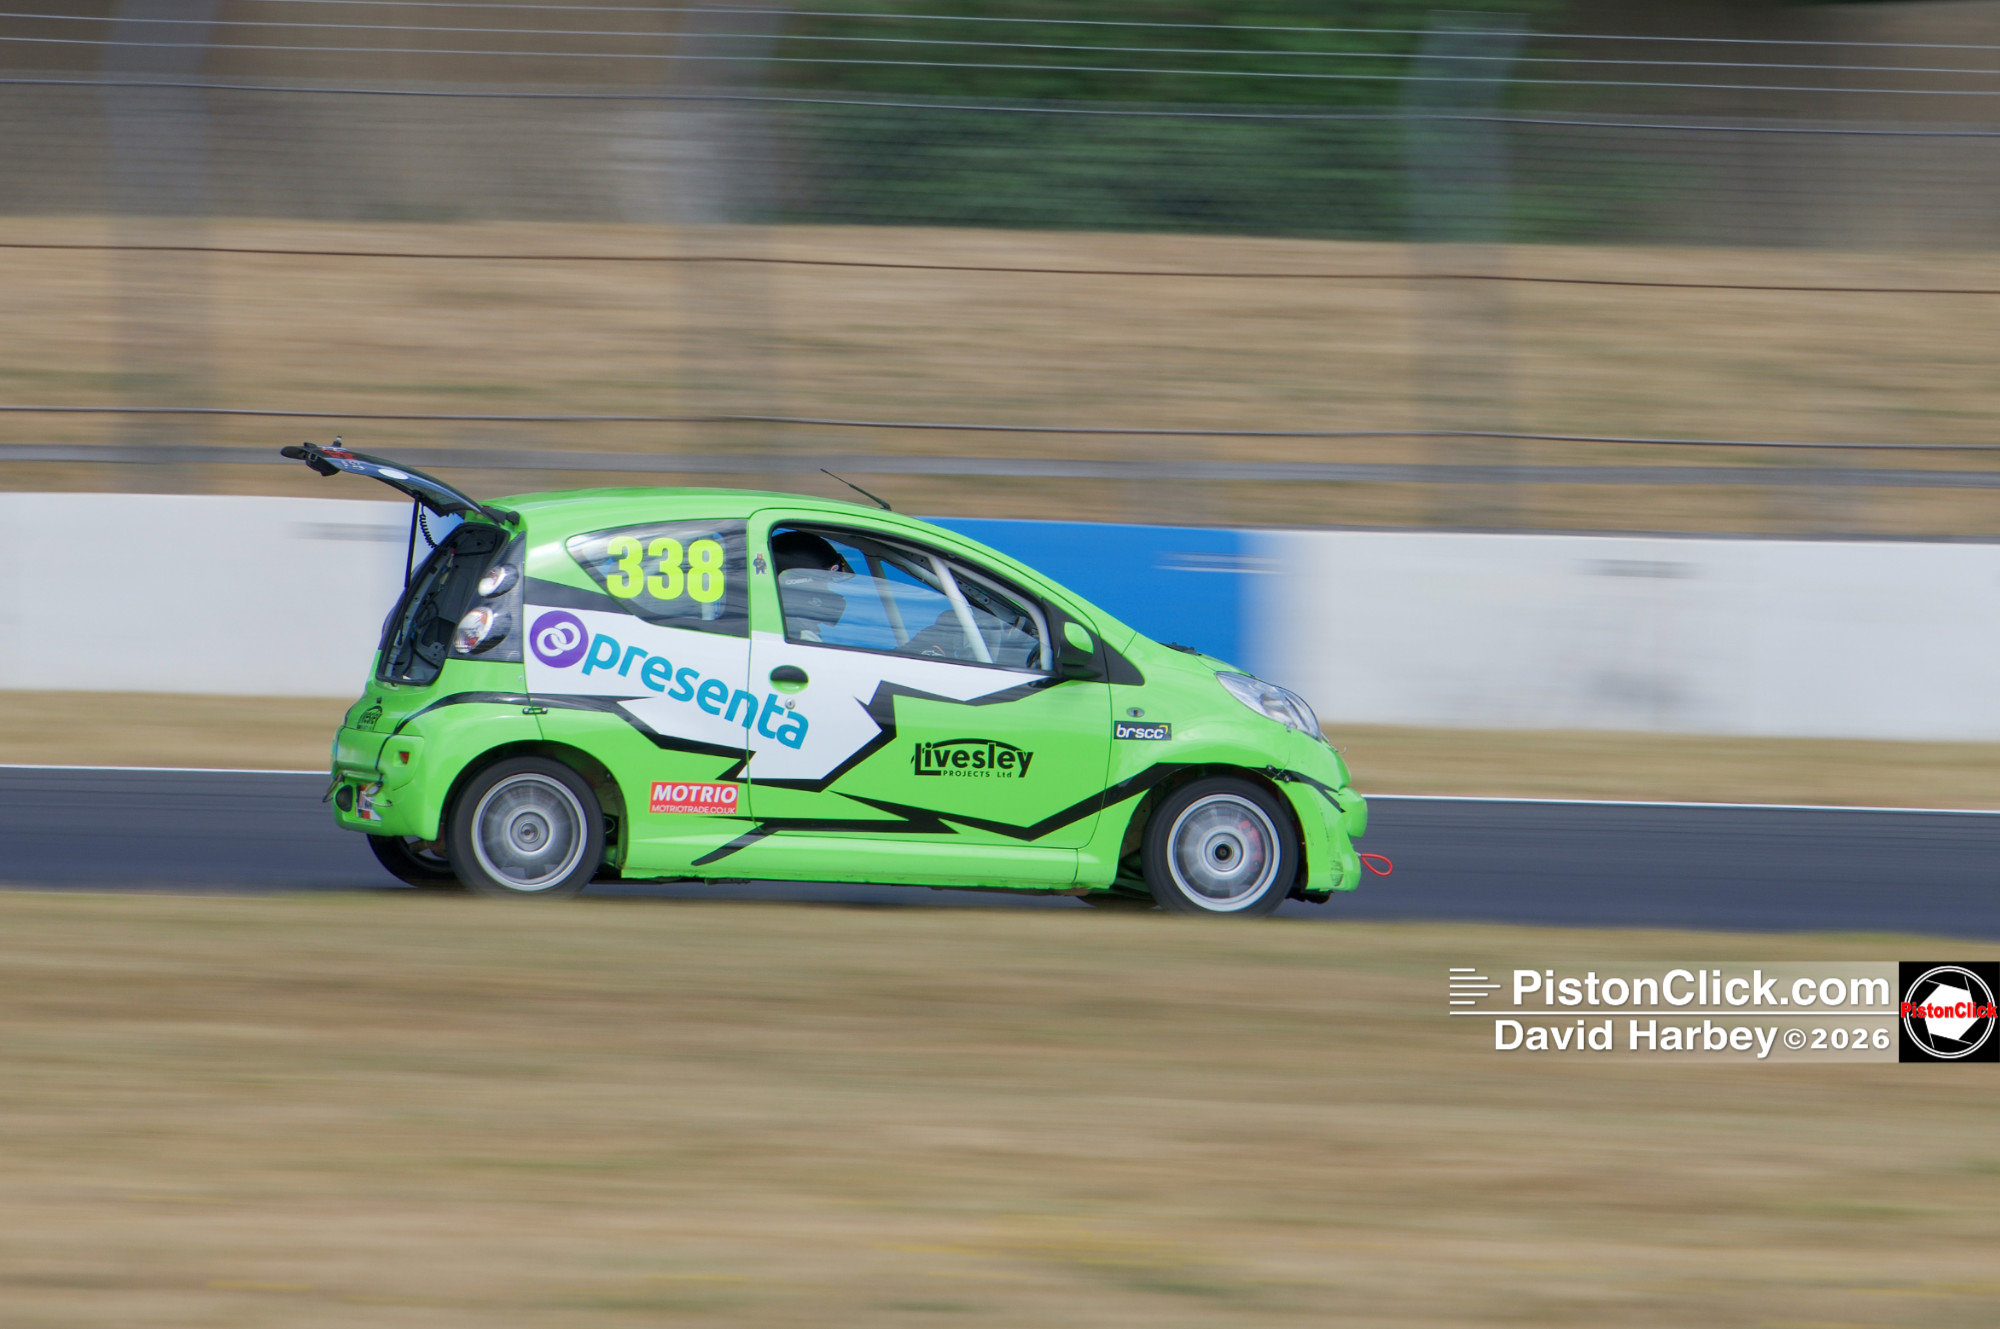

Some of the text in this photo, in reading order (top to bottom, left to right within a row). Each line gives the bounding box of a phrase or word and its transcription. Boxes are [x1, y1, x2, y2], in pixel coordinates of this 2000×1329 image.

[607, 535, 726, 604] 338
[581, 633, 809, 750] presenta
[1116, 723, 1165, 739] brscc
[914, 741, 1035, 779] Livesley
[943, 769, 1013, 779] PROJECTS Ltd
[652, 784, 738, 804] MOTRIO
[651, 804, 737, 816] MOTRIOTRADE.CO.UK
